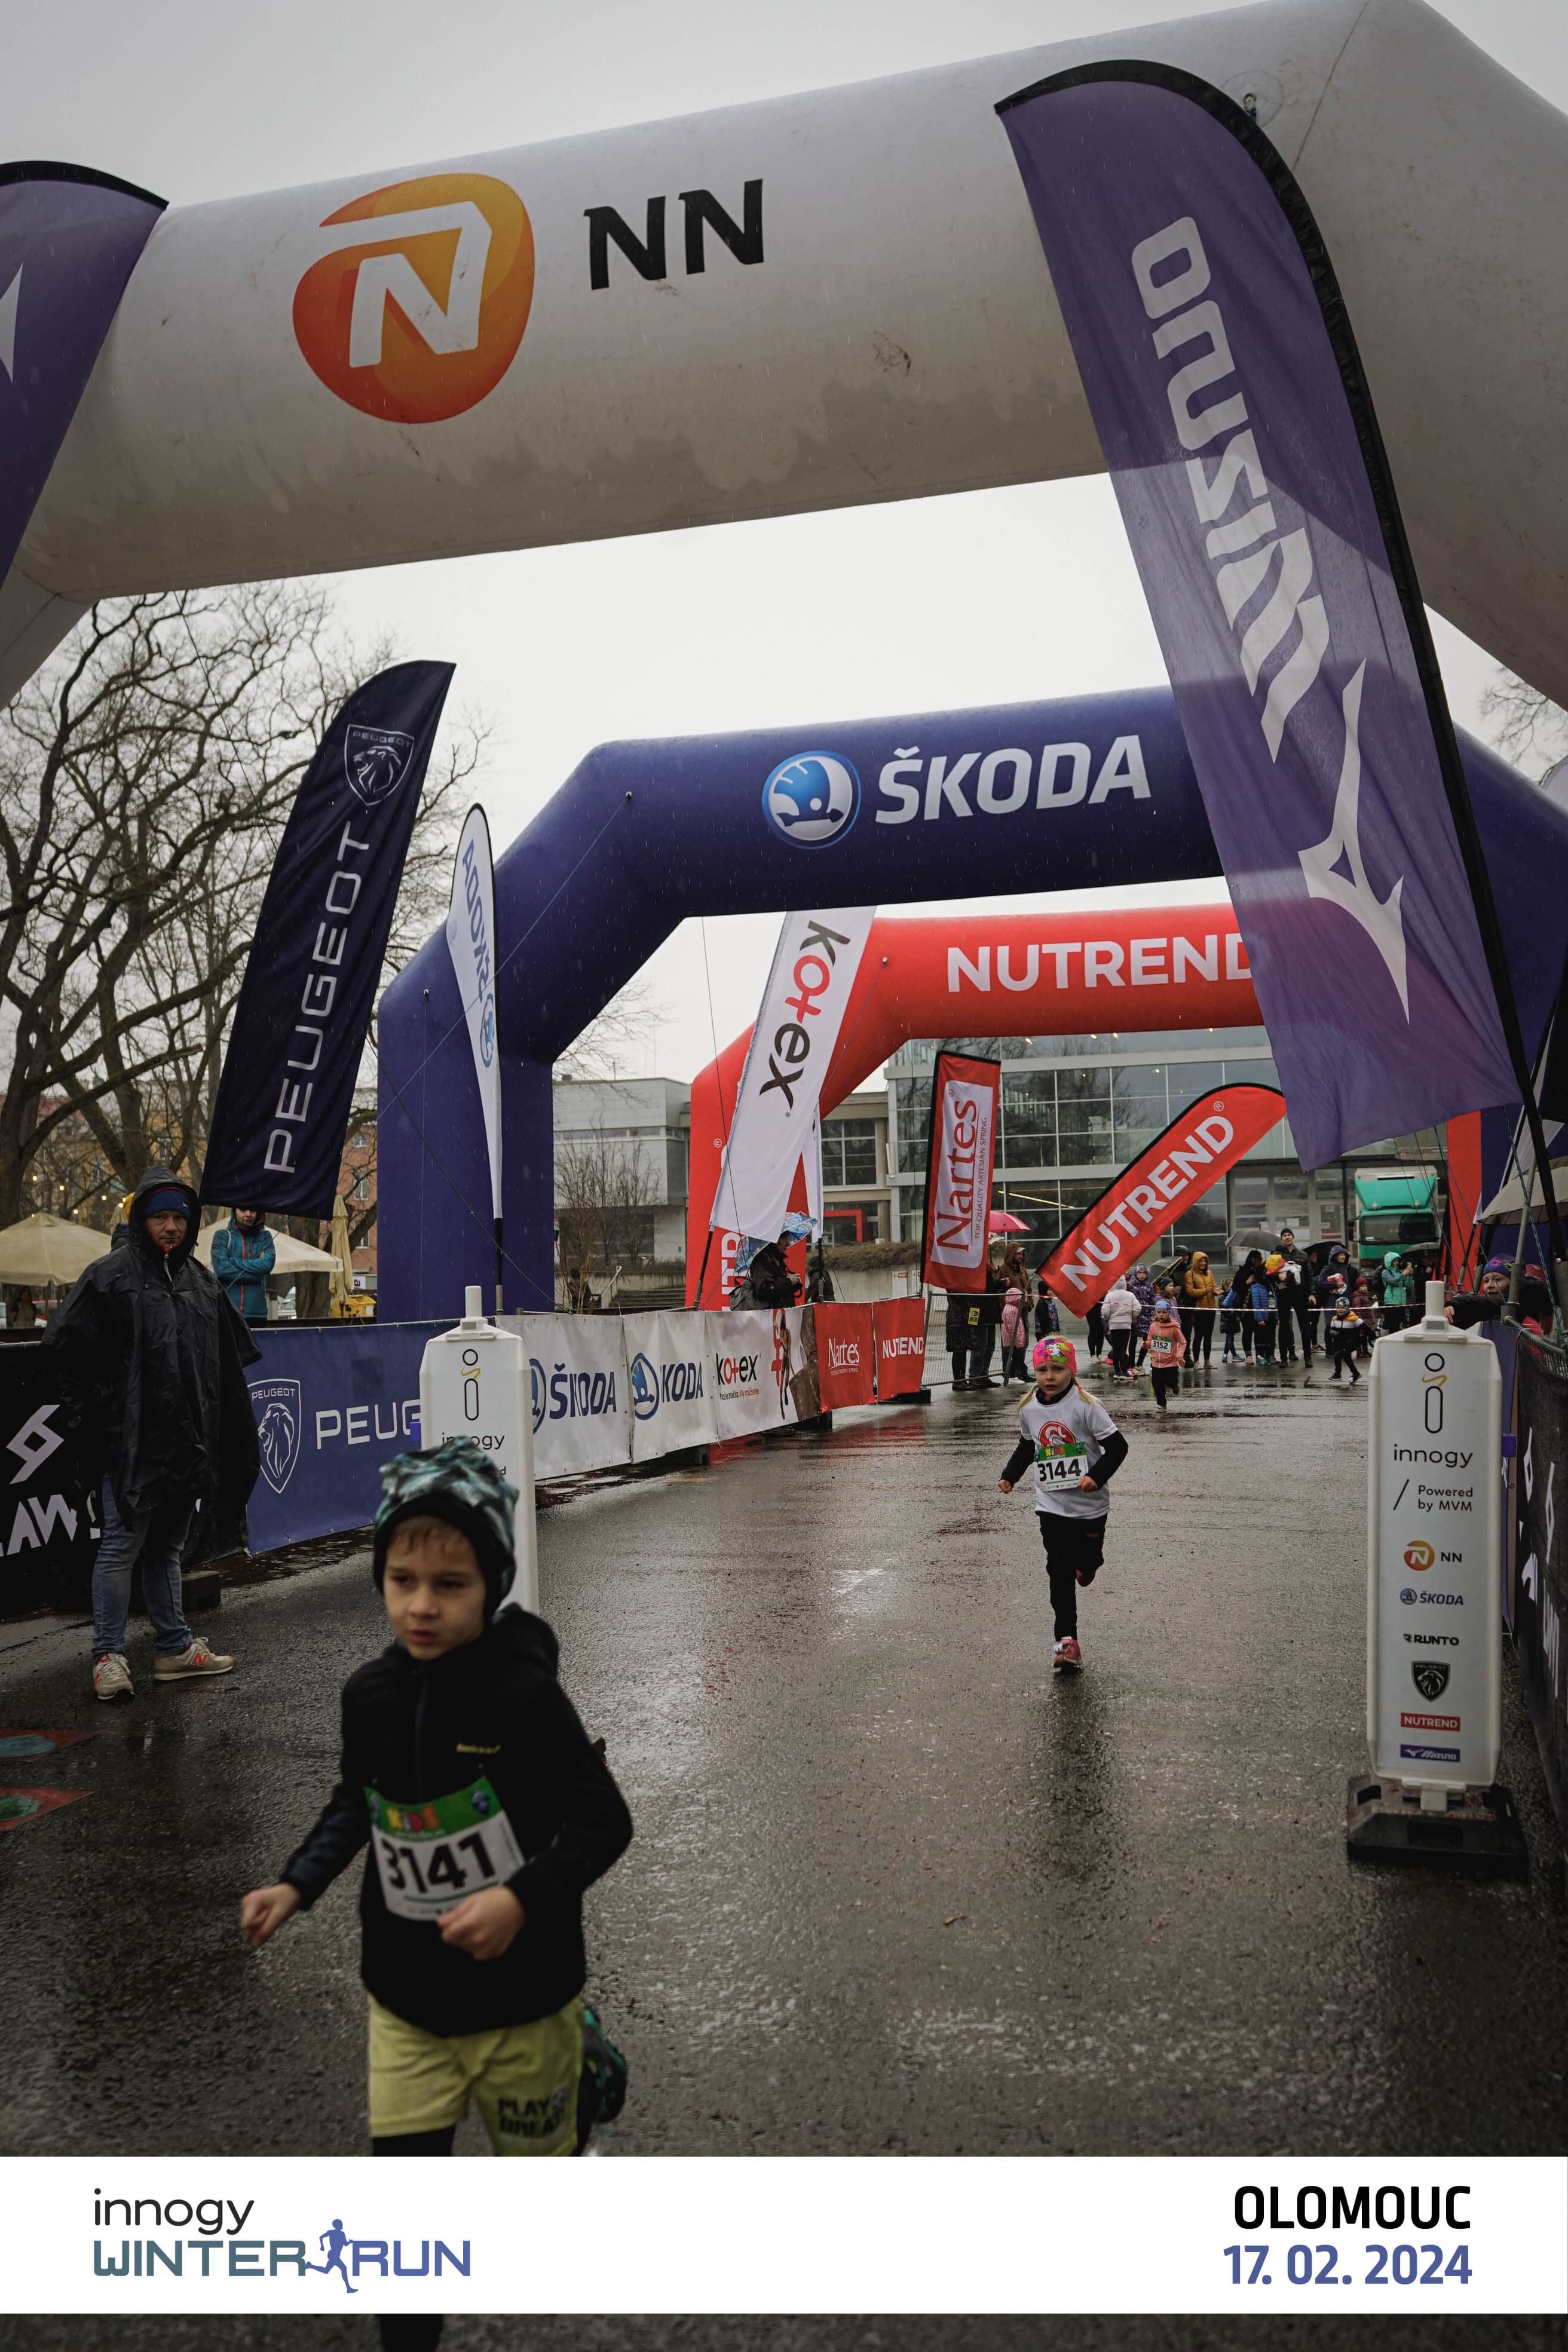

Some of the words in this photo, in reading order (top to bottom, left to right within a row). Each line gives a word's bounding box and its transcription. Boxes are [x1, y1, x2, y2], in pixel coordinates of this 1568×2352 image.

[583, 179, 765, 290] NN
[353, 730, 411, 748] PEUGEOT
[875, 734, 1152, 825] ŠKODA
[264, 821, 369, 1174] PEUGEOT
[936, 1099, 976, 1251] Nartes
[1060, 1116, 1234, 1291] NUTREND
[828, 1338, 859, 1367] Nartes
[1153, 1340, 1168, 1349] 3152
[252, 1388, 296, 1401] PEUGEOT
[316, 1398, 421, 1450] PEUG
[1394, 1444, 1473, 1468] innogy
[1037, 1459, 1082, 1482] 3144
[1418, 1484, 1473, 1497] Powered
[1418, 1498, 1434, 1512] by
[1439, 1500, 1472, 1511] MVM
[1441, 1552, 1462, 1563] NN
[1419, 1591, 1463, 1606] ŠKODA
[1404, 1716, 1458, 1729] NUTREND
[381, 1832, 495, 1894] 3141
